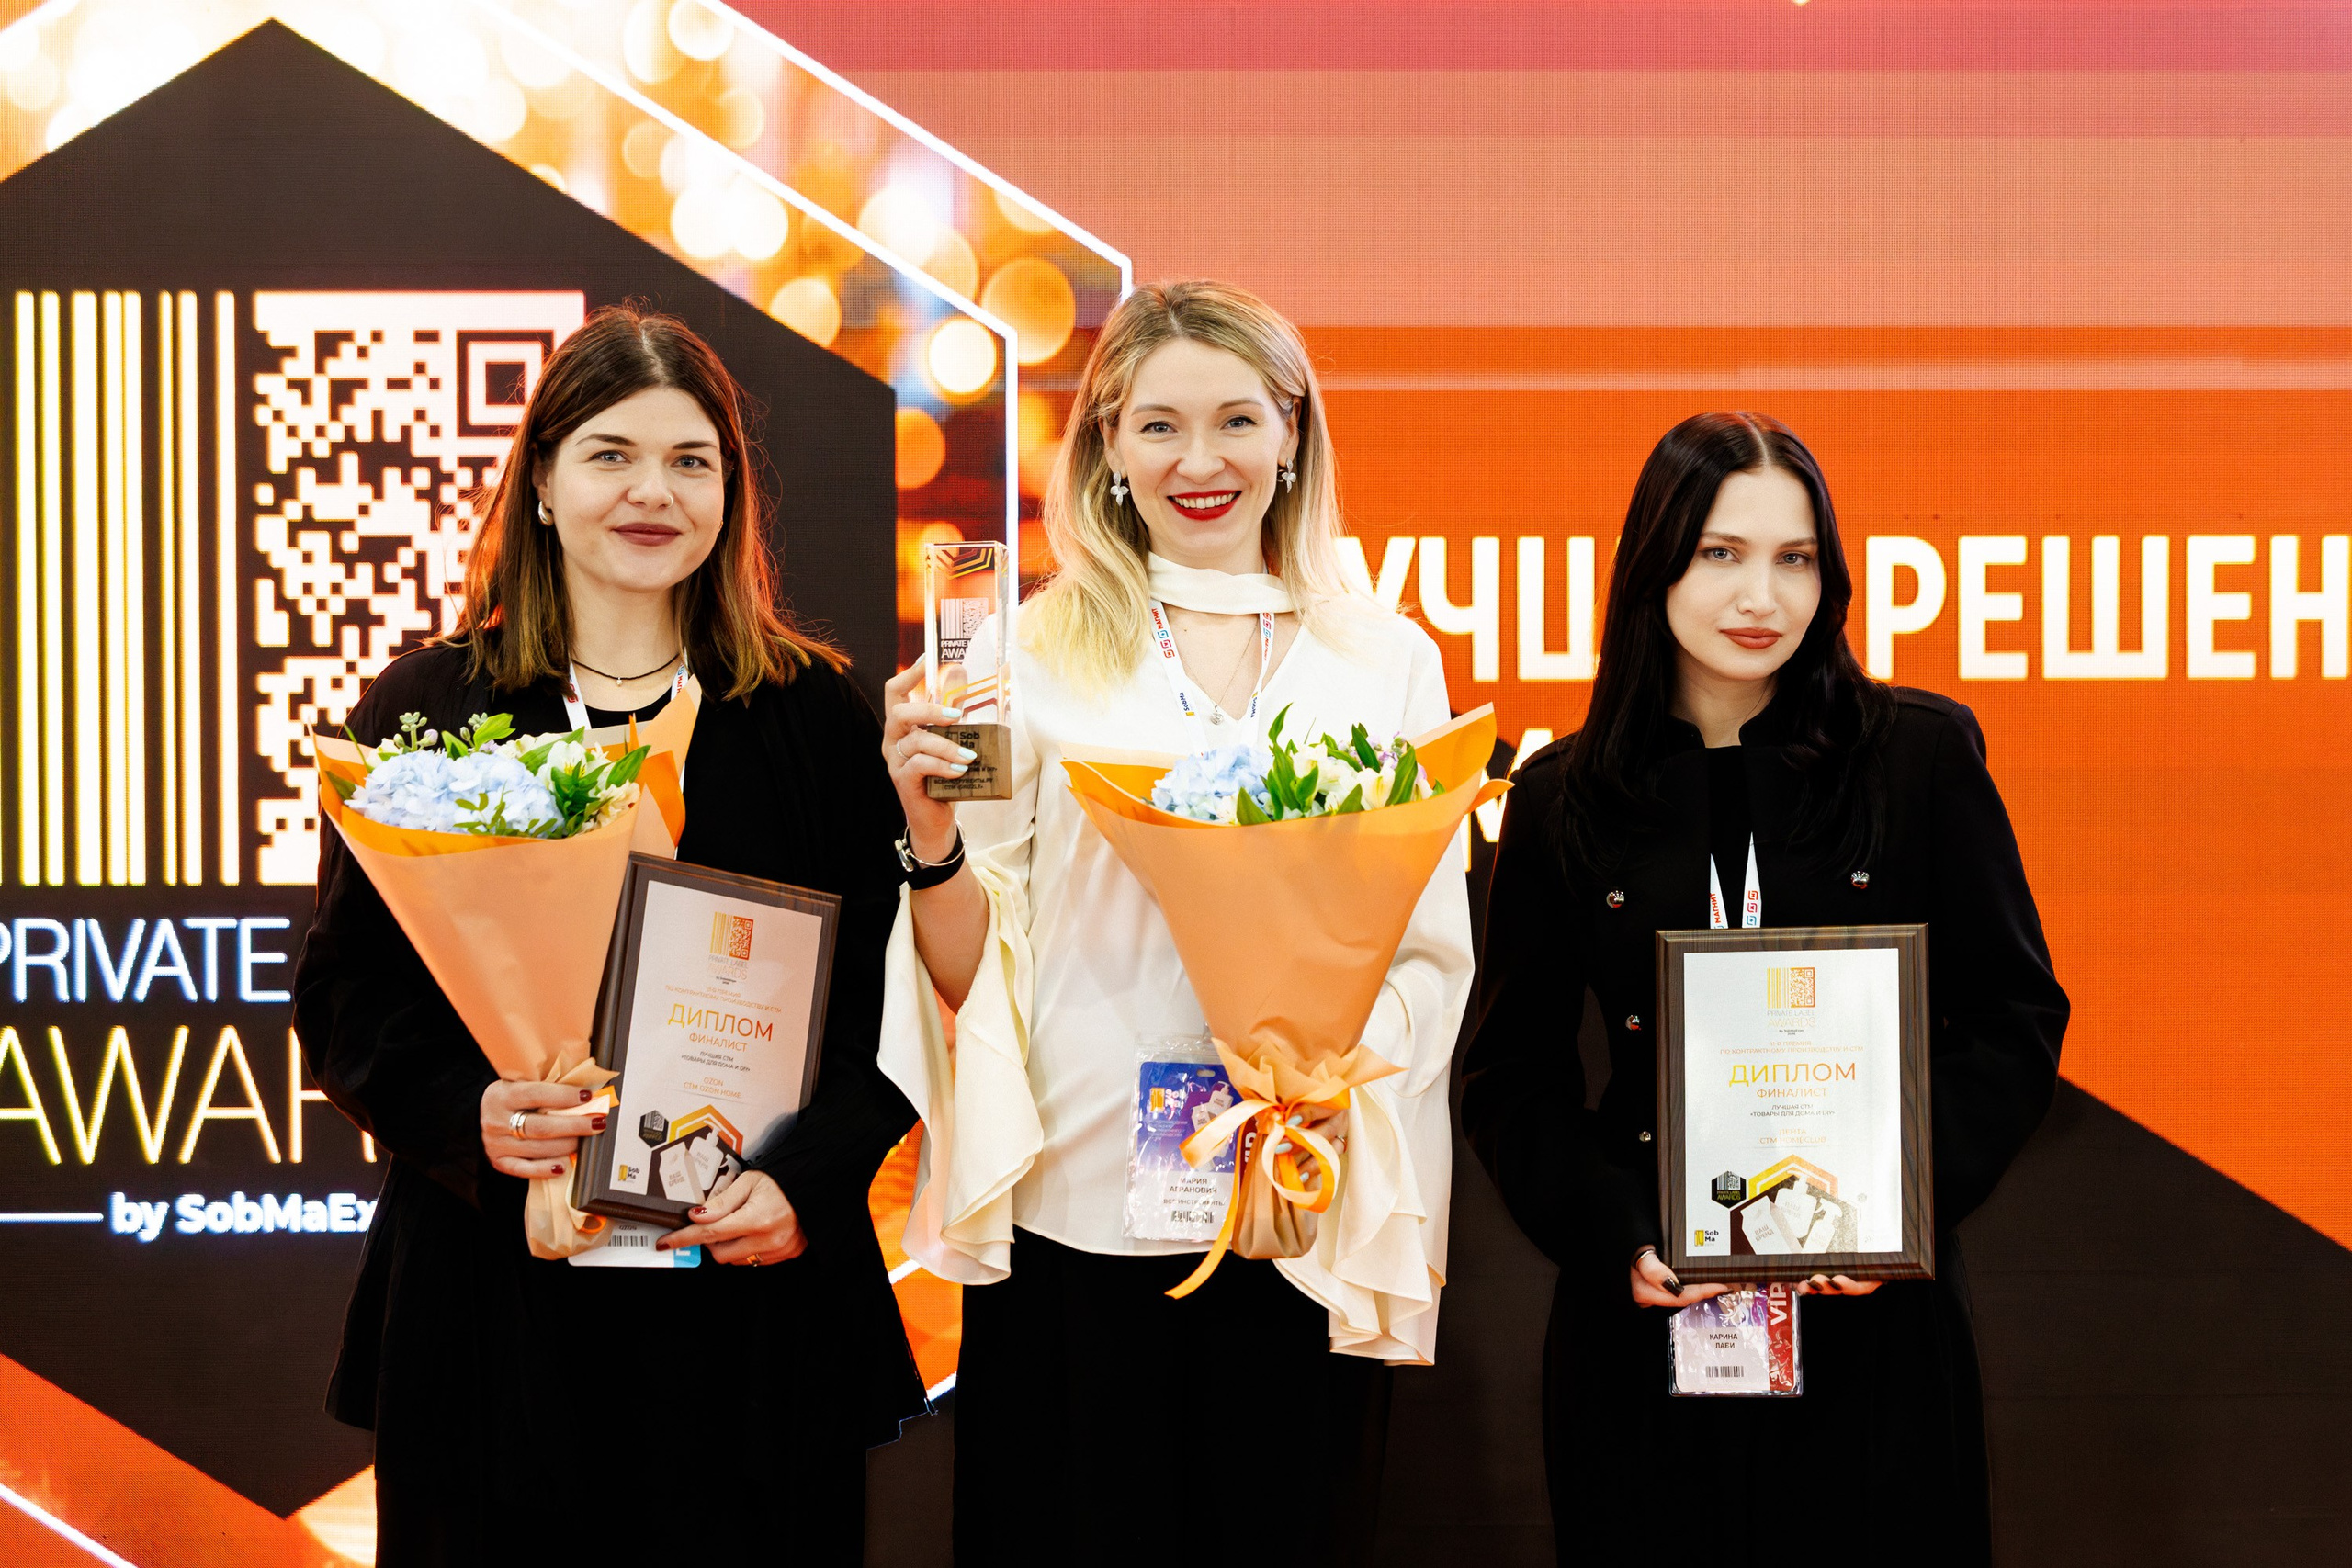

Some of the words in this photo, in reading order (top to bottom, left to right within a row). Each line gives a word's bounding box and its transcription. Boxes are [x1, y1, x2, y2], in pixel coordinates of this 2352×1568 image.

[1151, 608, 1163, 629] МАГНИТ
[1865, 534, 2351, 682] РЕШЕН
[959, 739, 975, 748] Ma
[0, 917, 291, 1003] RIVATE
[667, 1003, 774, 1042] ДИПЛОМ
[1768, 1017, 1816, 1028] AWARDS
[689, 1032, 747, 1052] ФИНАЛИСТ
[1728, 1063, 1856, 1087] ДИПЛОМ
[1757, 1088, 1828, 1098] ФИНАЛИСТ
[110, 1191, 169, 1243] by
[1770, 1282, 1788, 1326] VIP
